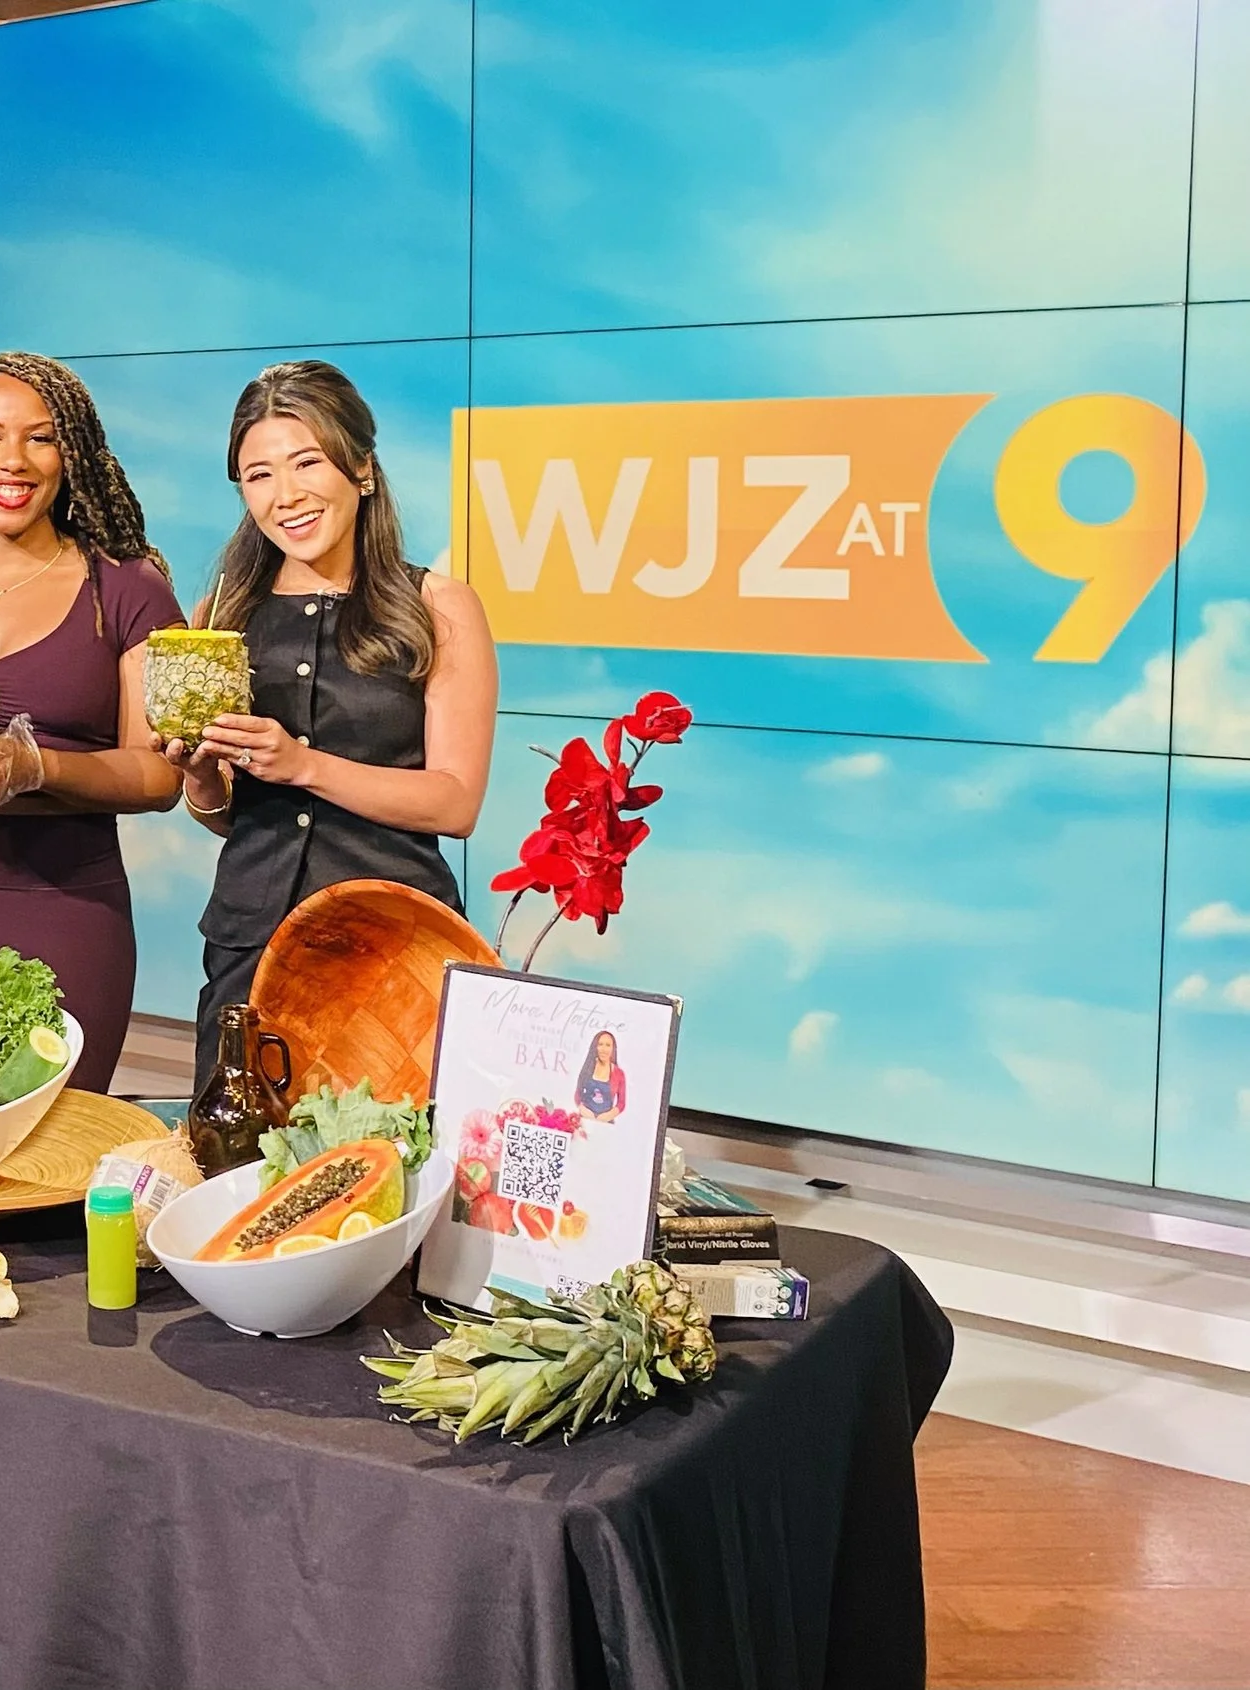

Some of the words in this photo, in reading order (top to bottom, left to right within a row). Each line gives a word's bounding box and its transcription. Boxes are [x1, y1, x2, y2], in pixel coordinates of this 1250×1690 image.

[472, 454, 851, 600] WJZ
[836, 502, 921, 557] AT
[994, 392, 1208, 664] 9
[515, 1042, 569, 1075] BAR
[687, 1240, 738, 1251] Vinyl/Nitrile
[740, 1240, 770, 1249] Gloves
